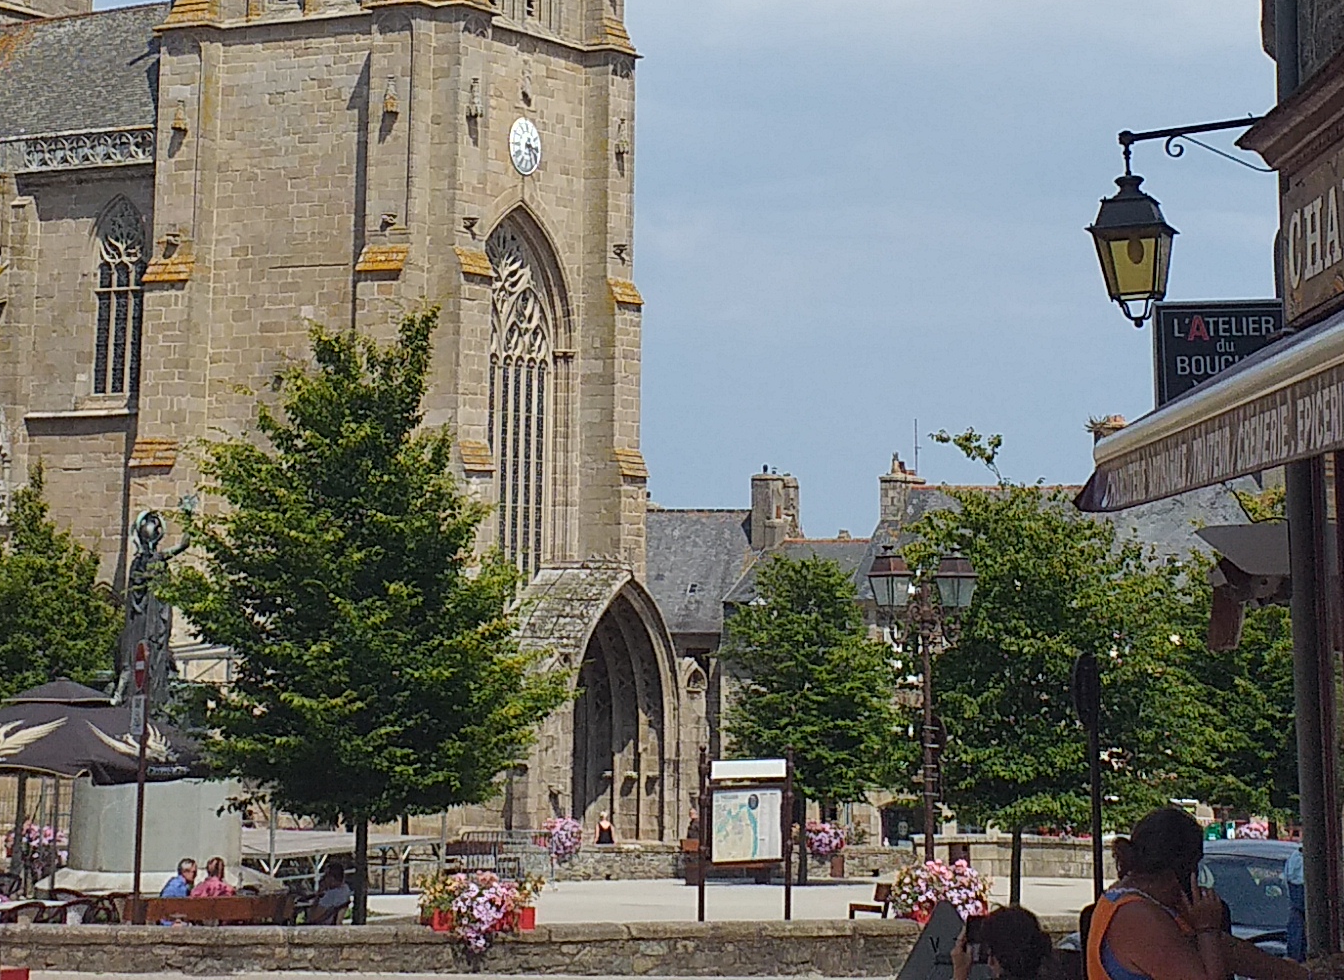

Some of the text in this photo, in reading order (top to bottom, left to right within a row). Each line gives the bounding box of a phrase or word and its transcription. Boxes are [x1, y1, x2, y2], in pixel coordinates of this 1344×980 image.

[1173, 314, 1275, 342] L'ATELIER
[1216, 338, 1235, 353] du
[1176, 354, 1248, 376] BOUC
